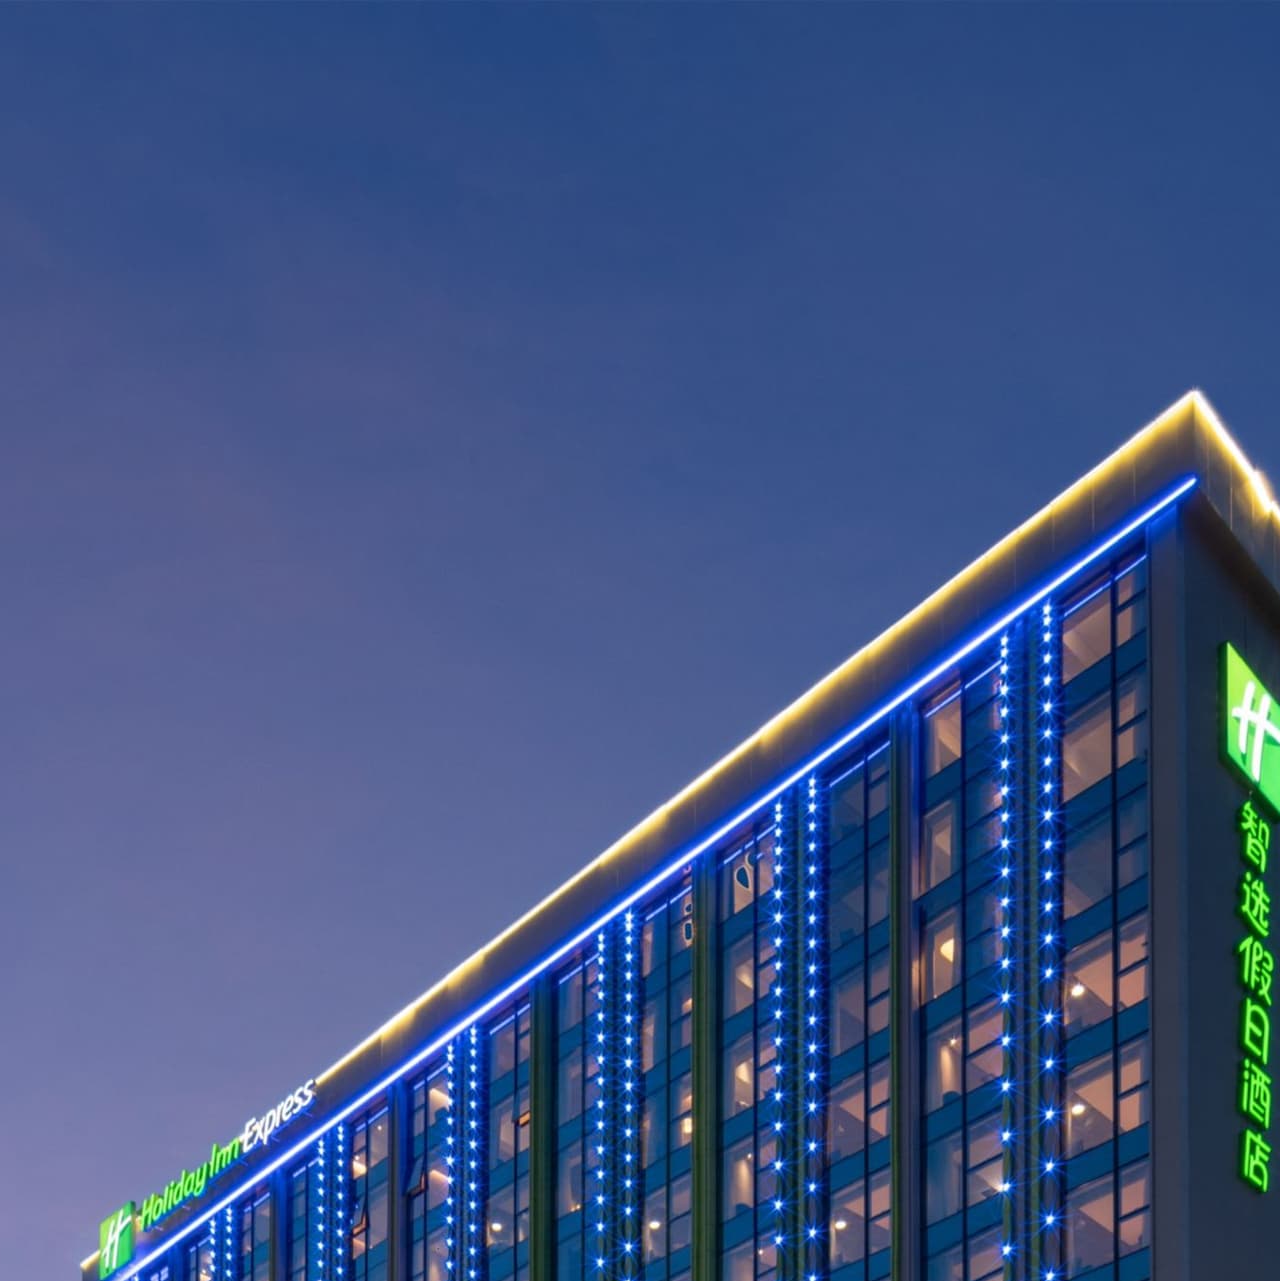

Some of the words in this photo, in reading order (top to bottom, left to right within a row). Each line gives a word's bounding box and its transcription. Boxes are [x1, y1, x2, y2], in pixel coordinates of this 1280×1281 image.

[1239, 801, 1274, 1192] 智选假日酒店
[140, 1162, 208, 1232] Holiday
[209, 1136, 240, 1178] Inn
[241, 1079, 314, 1153] Express
